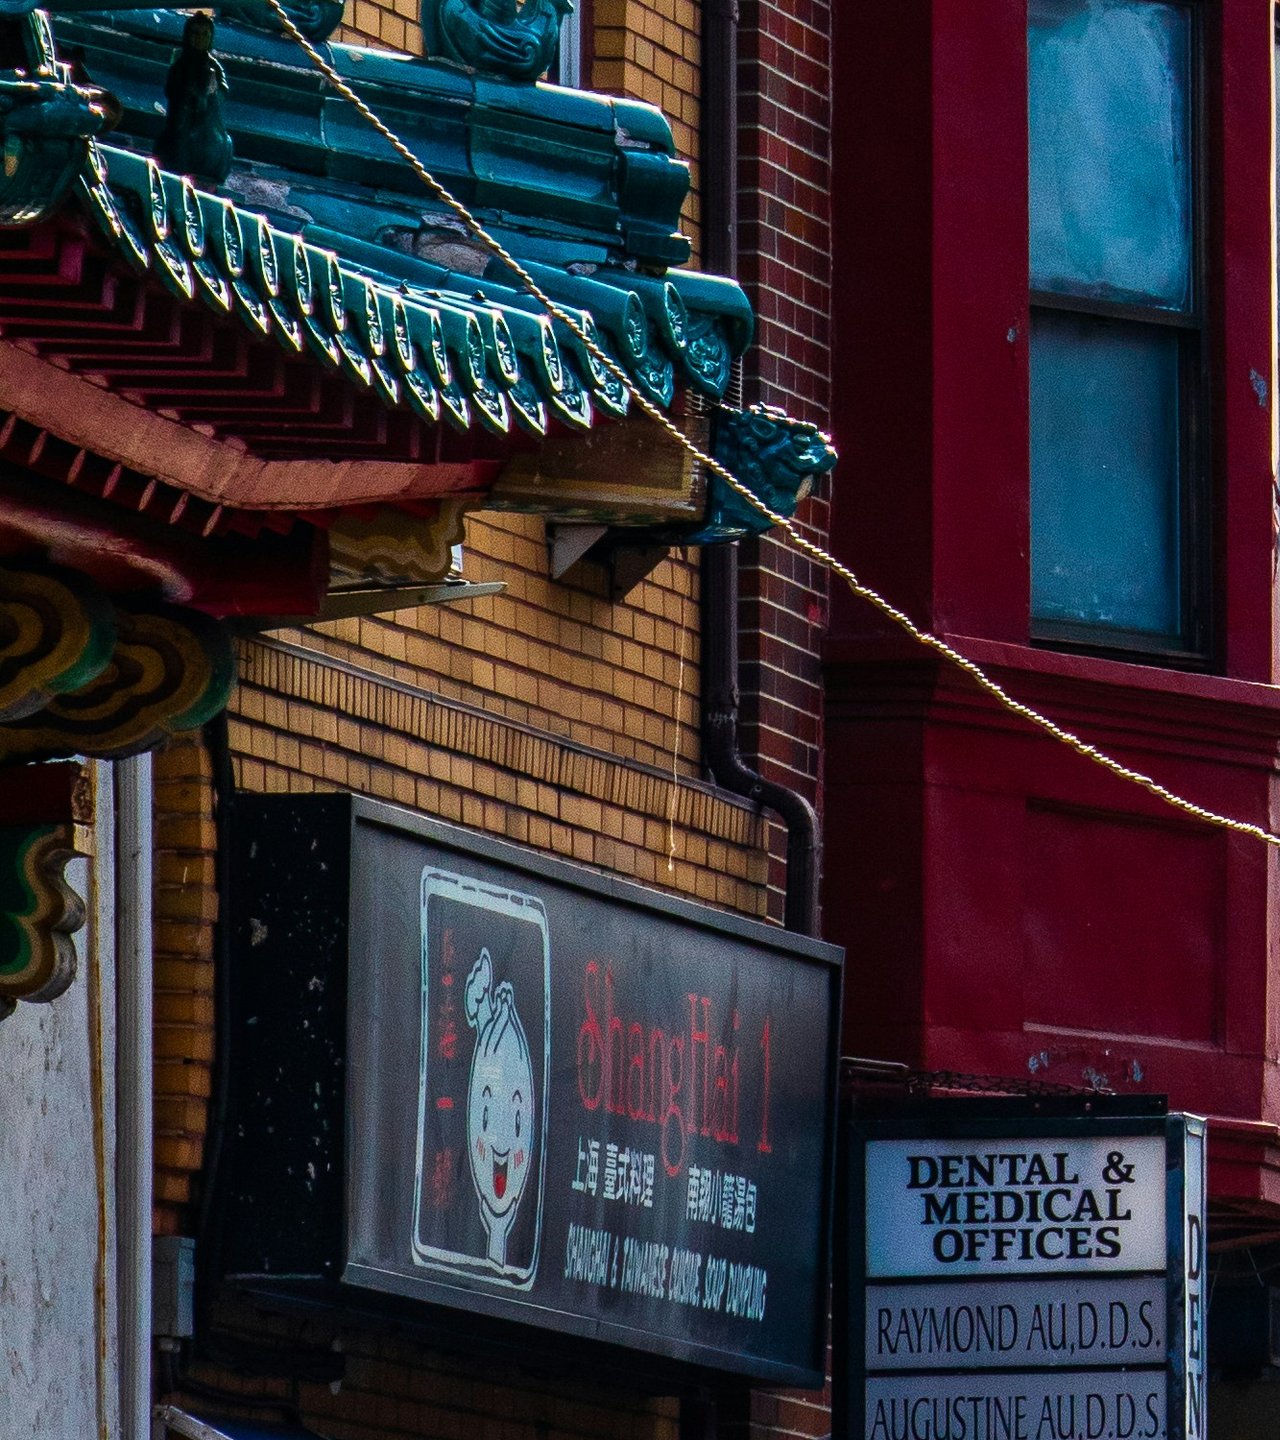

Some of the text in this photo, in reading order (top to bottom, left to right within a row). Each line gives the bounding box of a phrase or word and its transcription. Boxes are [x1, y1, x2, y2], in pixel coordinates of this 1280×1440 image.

[906, 1151, 1136, 1190] DENTAL &
[920, 1188, 1132, 1226] MEDICAL
[932, 1226, 1122, 1264] OFFICES
[877, 1303, 1019, 1355] RAYMOND
